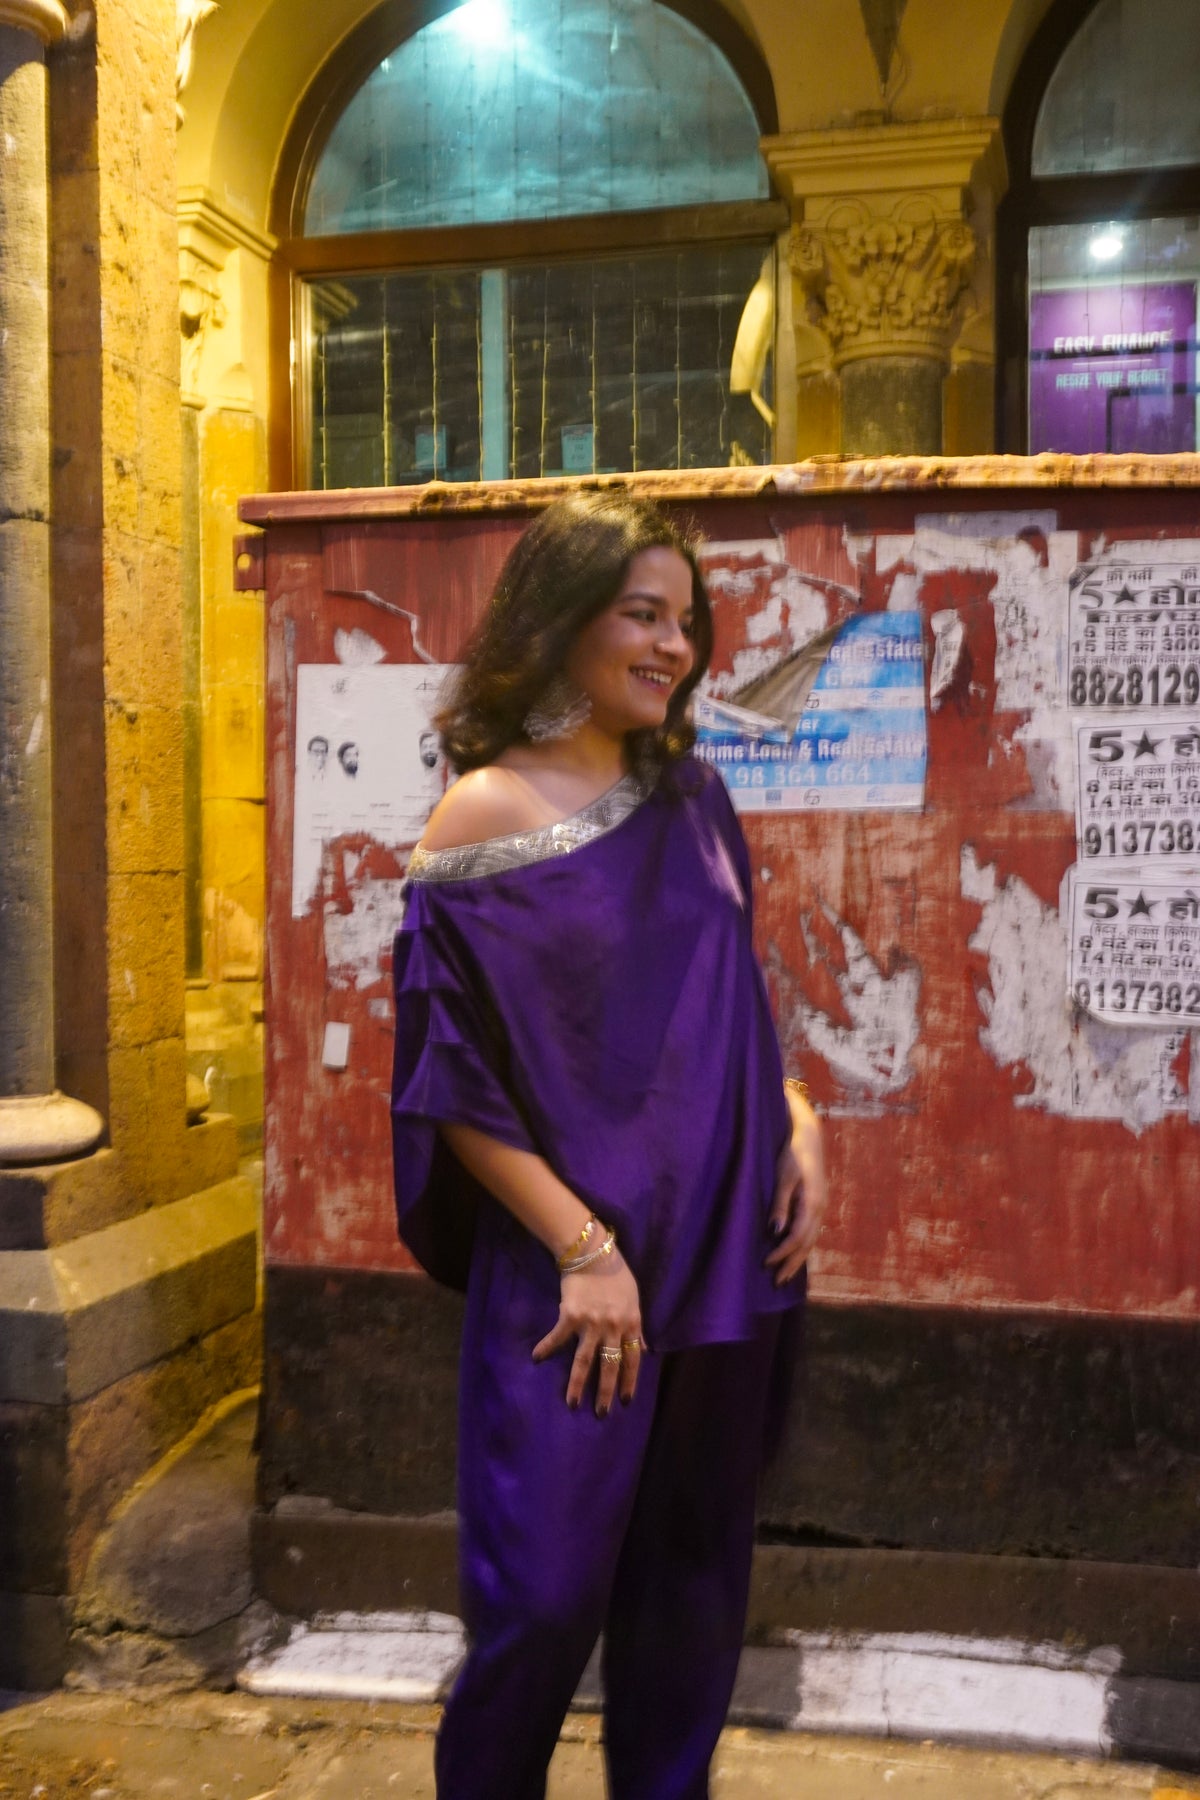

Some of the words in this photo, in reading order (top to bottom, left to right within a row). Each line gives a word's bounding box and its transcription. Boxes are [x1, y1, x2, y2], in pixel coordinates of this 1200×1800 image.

[1053, 335, 1095, 354] EASY
[1101, 330, 1173, 351] FINANCE
[1079, 579, 1105, 610] 5
[1070, 664, 1200, 705] 8828129
[694, 741, 745, 761] Home
[749, 741, 793, 761] Loan
[1088, 729, 1125, 762] 5
[735, 765, 764, 786] 98
[774, 764, 816, 785] 364
[826, 763, 871, 784] 664
[1084, 819, 1200, 856] 913738
[1083, 886, 1120, 919] 5
